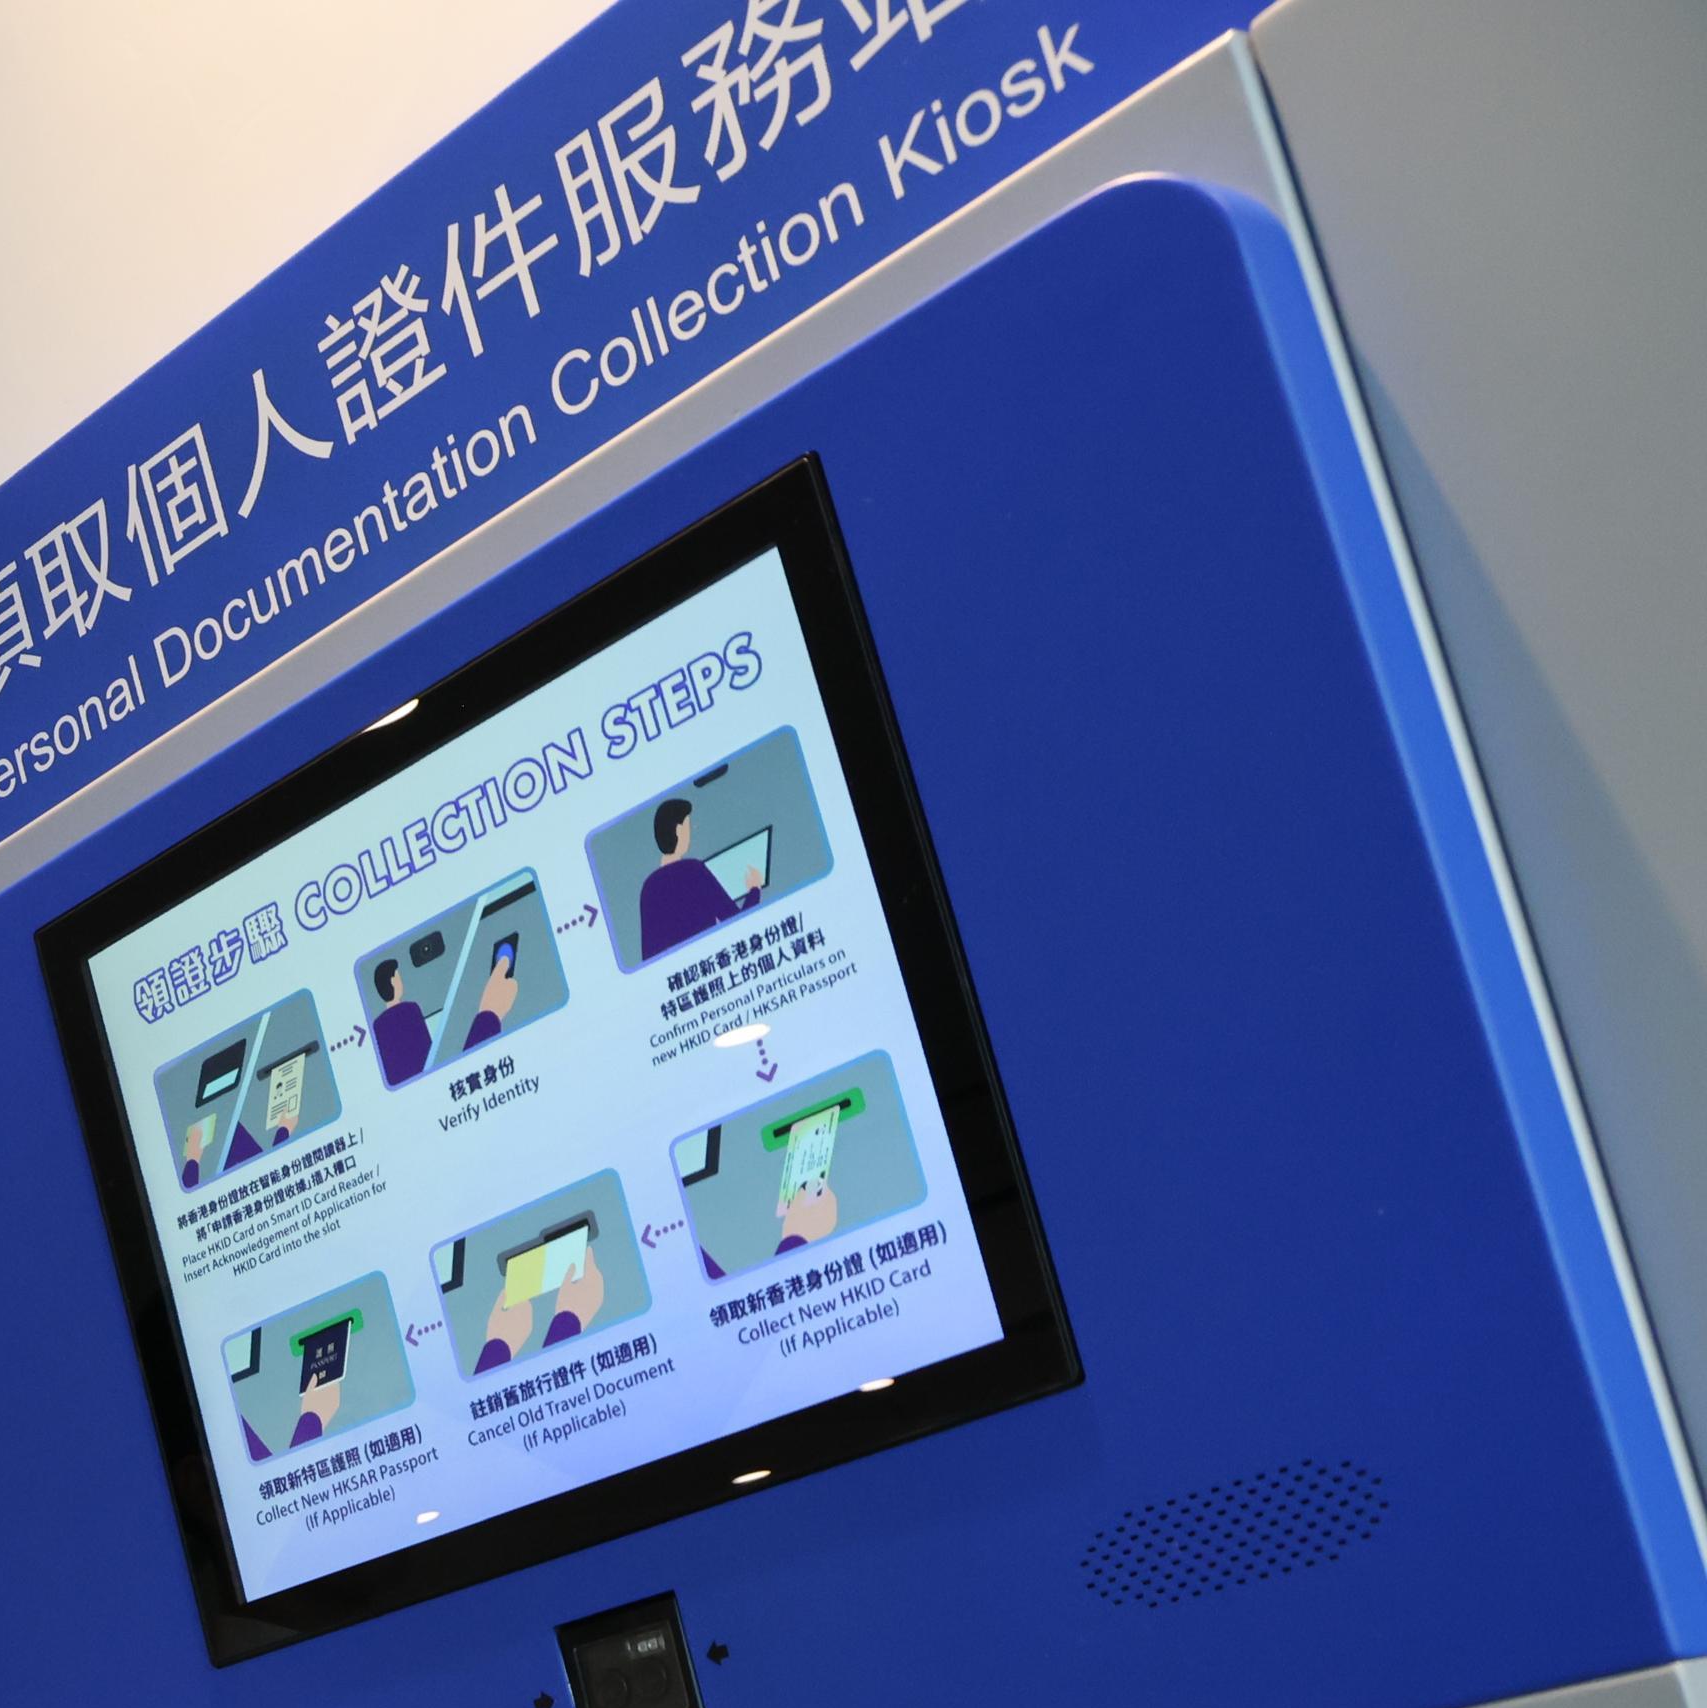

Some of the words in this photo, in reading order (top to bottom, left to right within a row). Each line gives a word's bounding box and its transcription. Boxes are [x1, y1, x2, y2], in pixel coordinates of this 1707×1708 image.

[156, 396, 538, 691] Documentation
[548, 182, 865, 417] Collection
[877, 22, 1095, 201] Kiosk
[133, 902, 288, 1025] 領證步驟
[294, 727, 593, 932] COLLECTION
[601, 631, 762, 759] STEPS
[650, 1018, 698, 1048] Confirm
[700, 989, 755, 1025] Personal
[756, 959, 826, 998] Particulars
[828, 949, 846, 964] on
[652, 1047, 678, 1067] new
[680, 1029, 711, 1053] HKID
[713, 1014, 743, 1038] Card
[753, 989, 798, 1019] HKSAR
[799, 962, 858, 997] Passport
[660, 928, 826, 1021] 特區護照上的個人資料
[438, 1103, 481, 1133] Verify
[483, 1074, 541, 1112] Identity
[448, 1055, 516, 1102] 核實身份
[182, 1249, 207, 1267] Place
[208, 1236, 232, 1255] HKID
[232, 1224, 255, 1243] Card
[256, 1220, 270, 1232] on
[270, 1205, 300, 1225] Smart
[301, 1198, 313, 1212] ID
[314, 1185, 338, 1205] Card
[338, 1169, 374, 1193] Reader
[184, 1263, 211, 1283] Insert
[212, 1222, 300, 1270] Acknowledgement
[302, 1213, 312, 1228] of
[314, 1188, 371, 1223] Application
[371, 1180, 387, 1196] for
[232, 1257, 257, 1277] HKID
[258, 1245, 282, 1264] Card
[282, 1237, 303, 1254] into
[303, 1229, 321, 1244] the
[322, 1218, 342, 1235] slot
[869, 1220, 948, 1270] (如適用)
[738, 1312, 796, 1345] Collect
[799, 1298, 836, 1323] New
[840, 1278, 885, 1308] HKID
[889, 1259, 932, 1288] Card
[780, 1335, 797, 1358] (If
[802, 1298, 900, 1349] Applicable)
[467, 1416, 516, 1446] Cancel
[518, 1405, 544, 1428] Old
[545, 1387, 591, 1418] Travel
[593, 1358, 676, 1400] Document
[469, 1359, 587, 1421] 註銷舊旅行證件
[590, 1332, 658, 1377] (如適用)
[259, 1447, 362, 1500] 領取新特區護照
[364, 1424, 422, 1463] (如適用)
[523, 1429, 538, 1452] (If
[542, 1399, 627, 1445] Applicable)
[256, 1500, 300, 1526] Collect
[300, 1489, 330, 1510] New
[332, 1469, 378, 1499] HKSAR
[379, 1447, 439, 1480] Passport
[305, 1510, 319, 1532] (If
[322, 1484, 396, 1525] Applicable)
